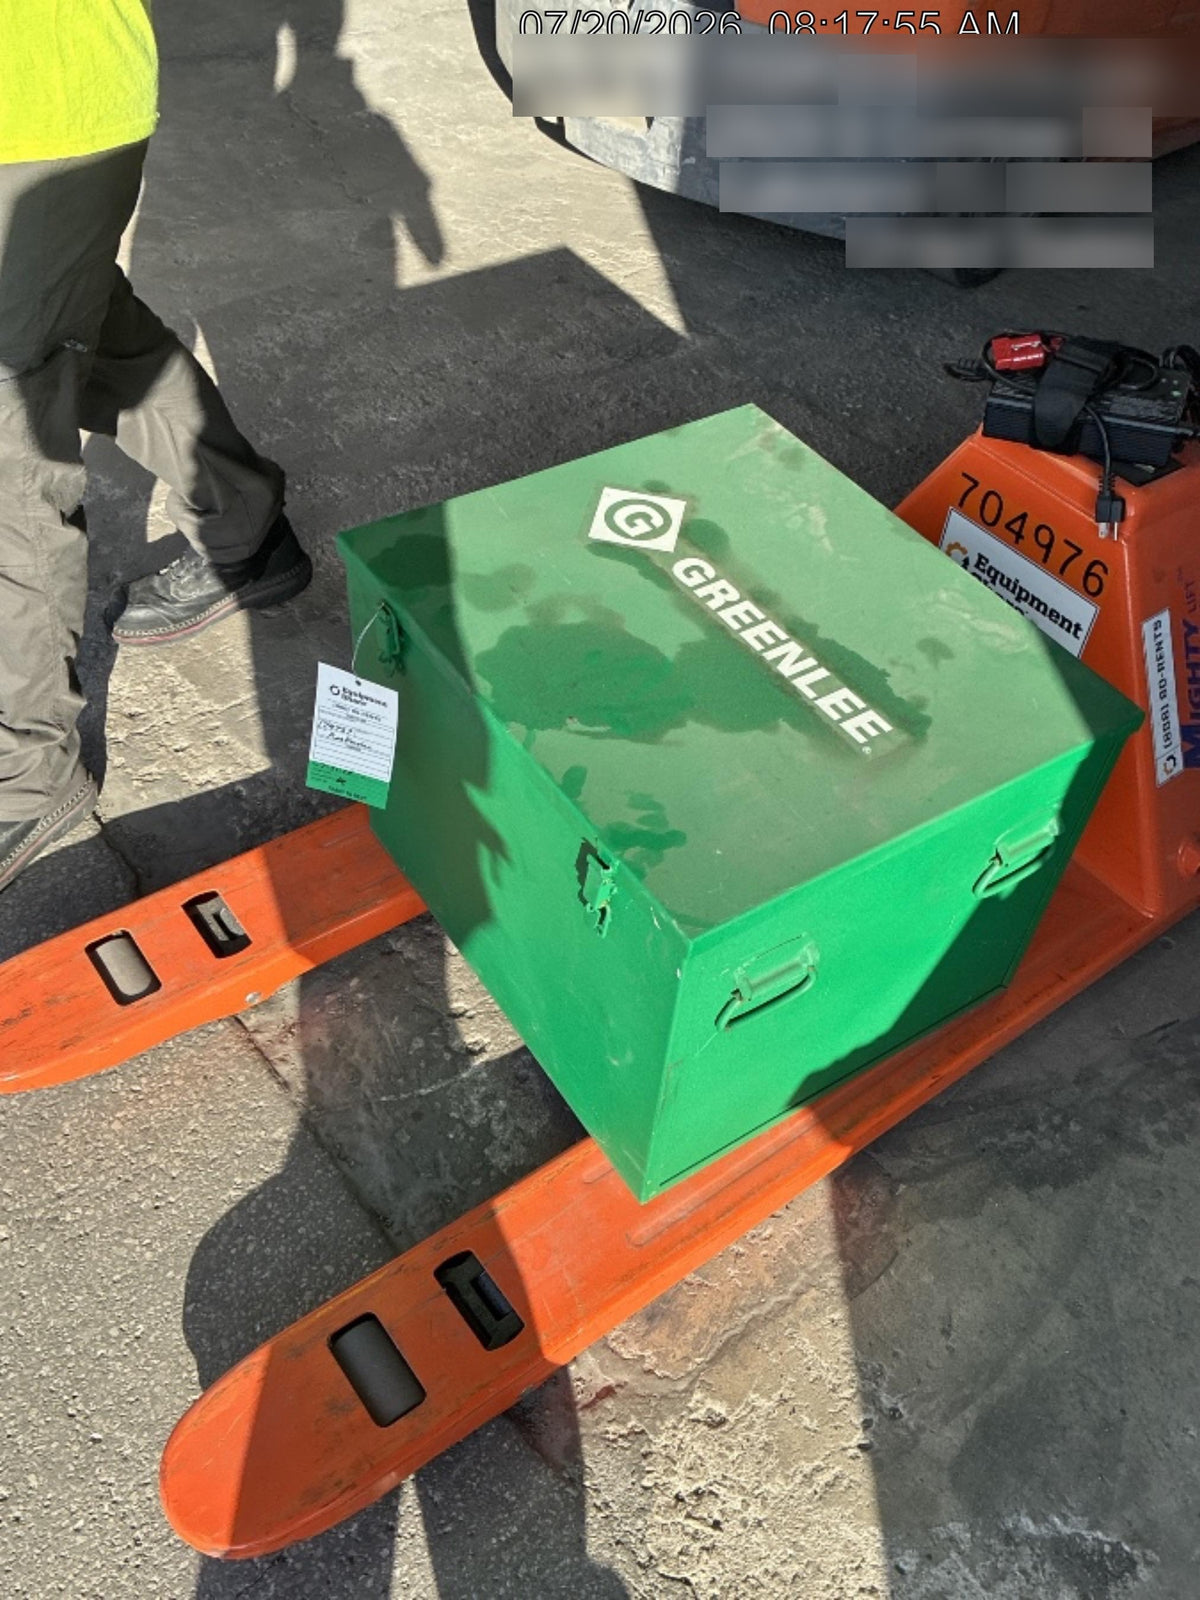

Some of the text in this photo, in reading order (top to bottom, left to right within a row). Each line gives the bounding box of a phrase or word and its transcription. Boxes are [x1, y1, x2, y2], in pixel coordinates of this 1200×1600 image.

[958, 472, 1108, 597] 704976
[974, 552, 1083, 640] Equipment
[672, 558, 893, 744] GREENLEE
